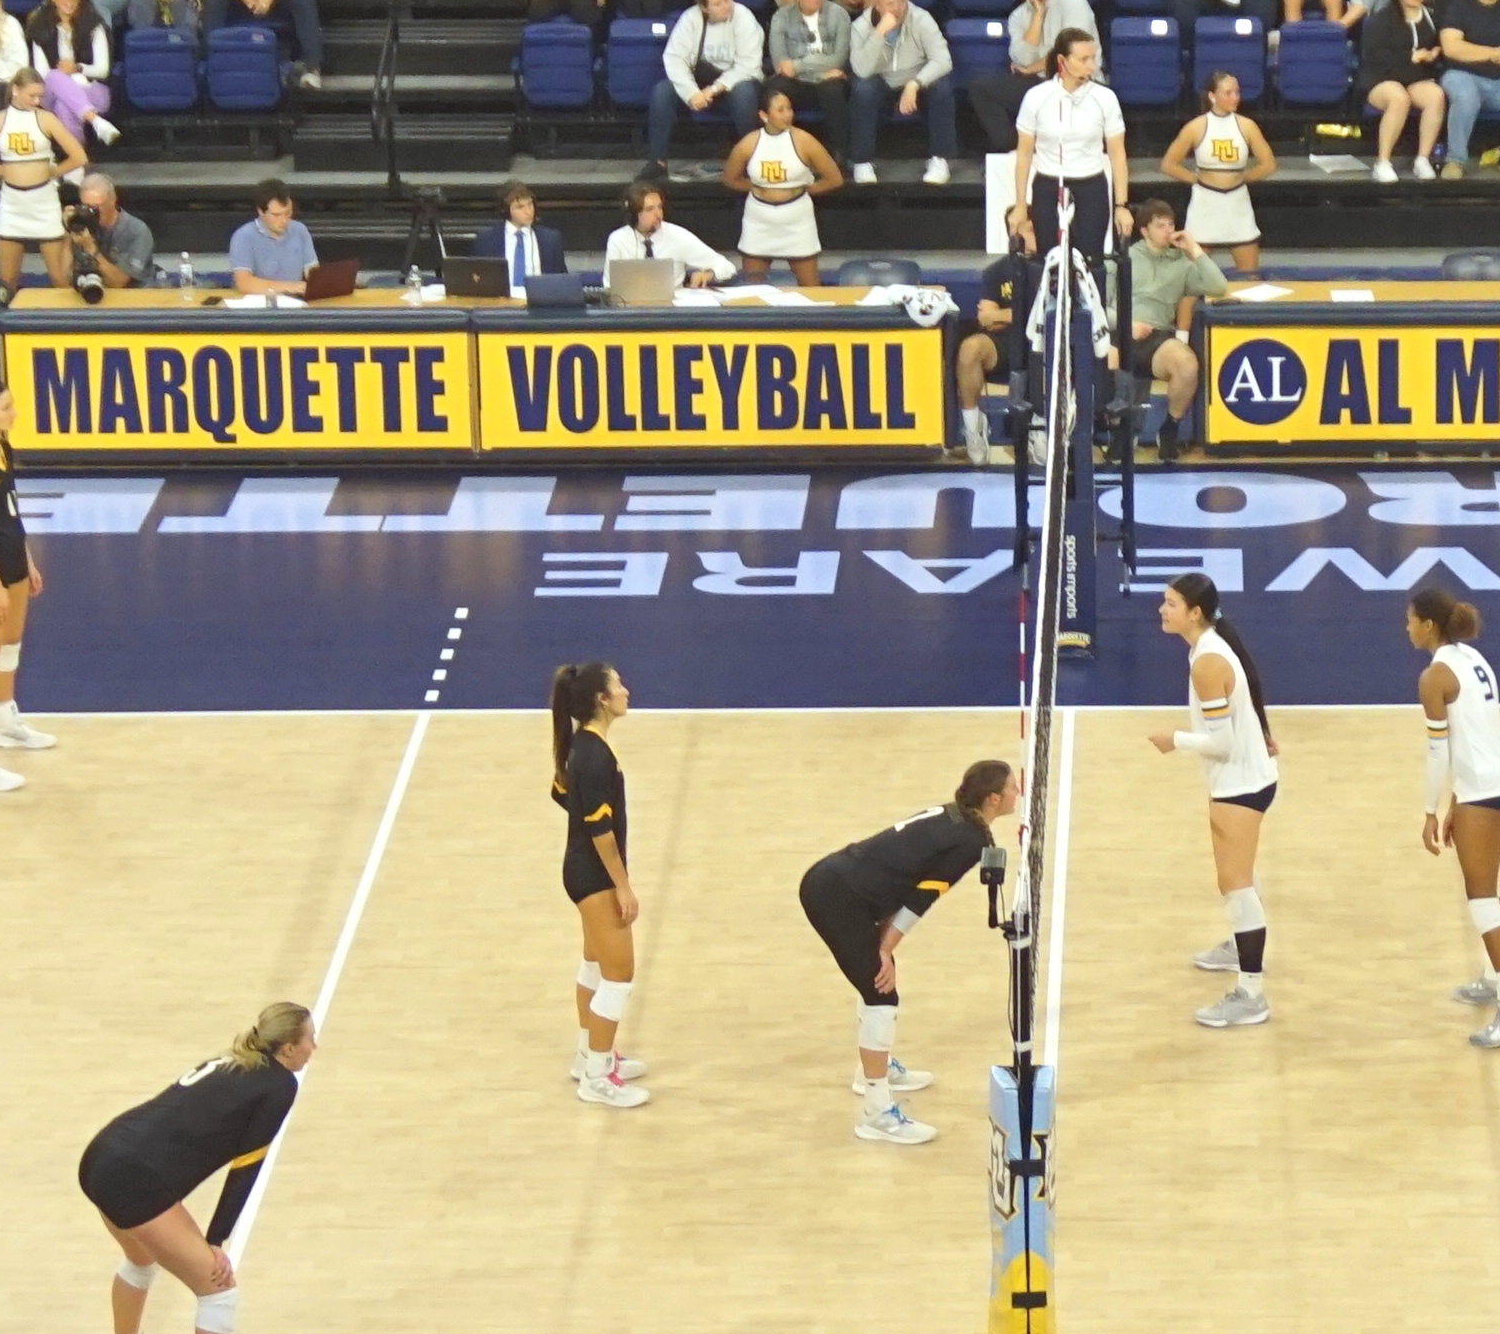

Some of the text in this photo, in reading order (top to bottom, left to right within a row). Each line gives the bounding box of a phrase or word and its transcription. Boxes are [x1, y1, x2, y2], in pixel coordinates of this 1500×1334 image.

[8, 132, 36, 155] MU
[1212, 139, 1239, 163] MU
[761, 160, 787, 184] MU
[32, 343, 915, 444] MARQUETTE VOLLEYBALL
[1224, 353, 1303, 404] AL
[1320, 340, 1412, 426] AL
[535, 550, 1023, 596] ARE
[1066, 535, 1078, 620] sports imports
[1473, 665, 1495, 701] 9
